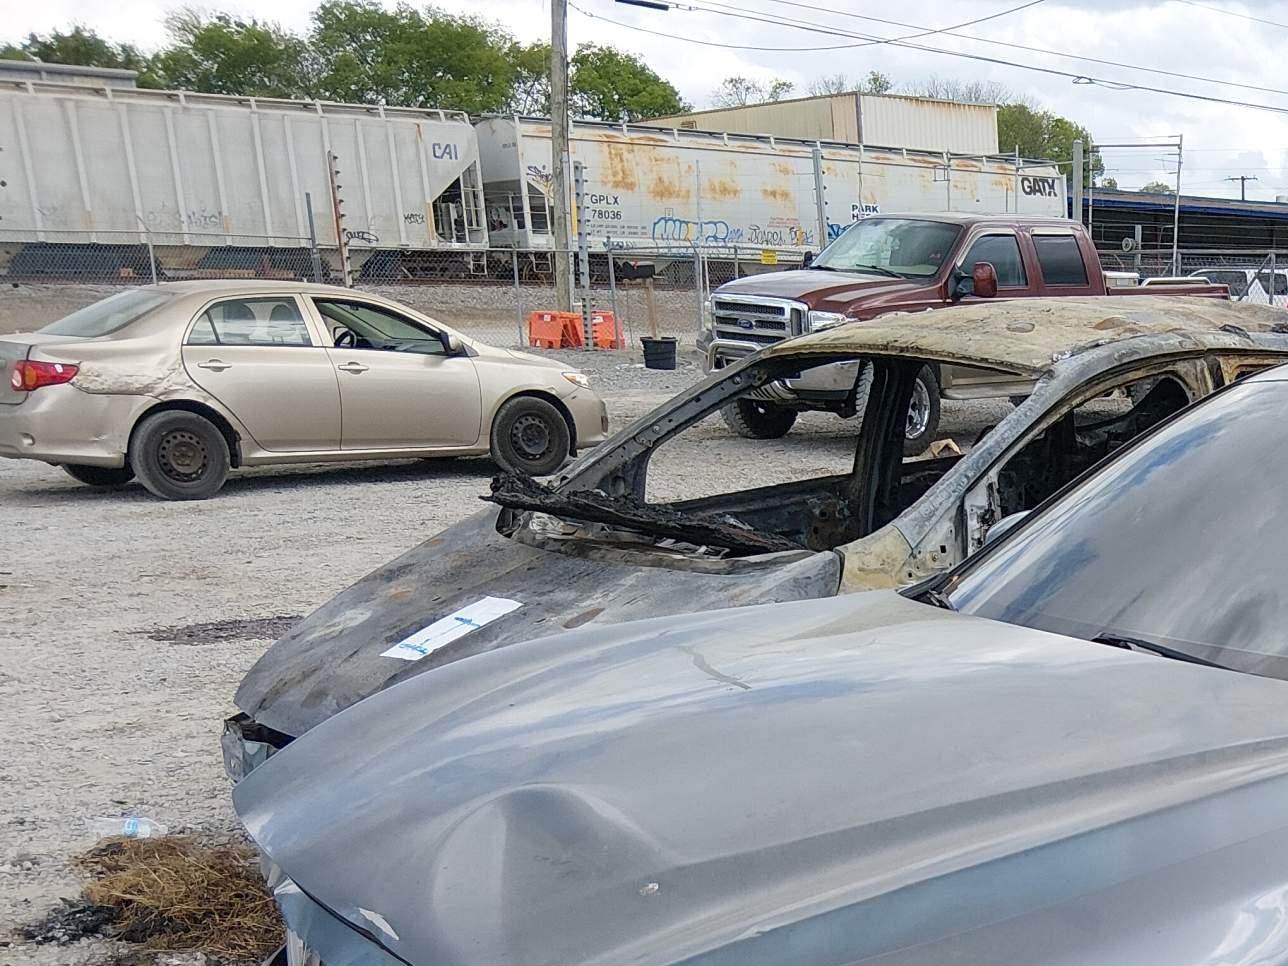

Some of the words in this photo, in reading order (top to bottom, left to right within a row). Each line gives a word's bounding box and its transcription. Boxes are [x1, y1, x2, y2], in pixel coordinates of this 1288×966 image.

[432, 142, 459, 160] CAI
[1020, 176, 1058, 197] GATX
[590, 194, 620, 206] GPLX
[591, 209, 622, 220] 78036
[851, 204, 879, 213] PARK
